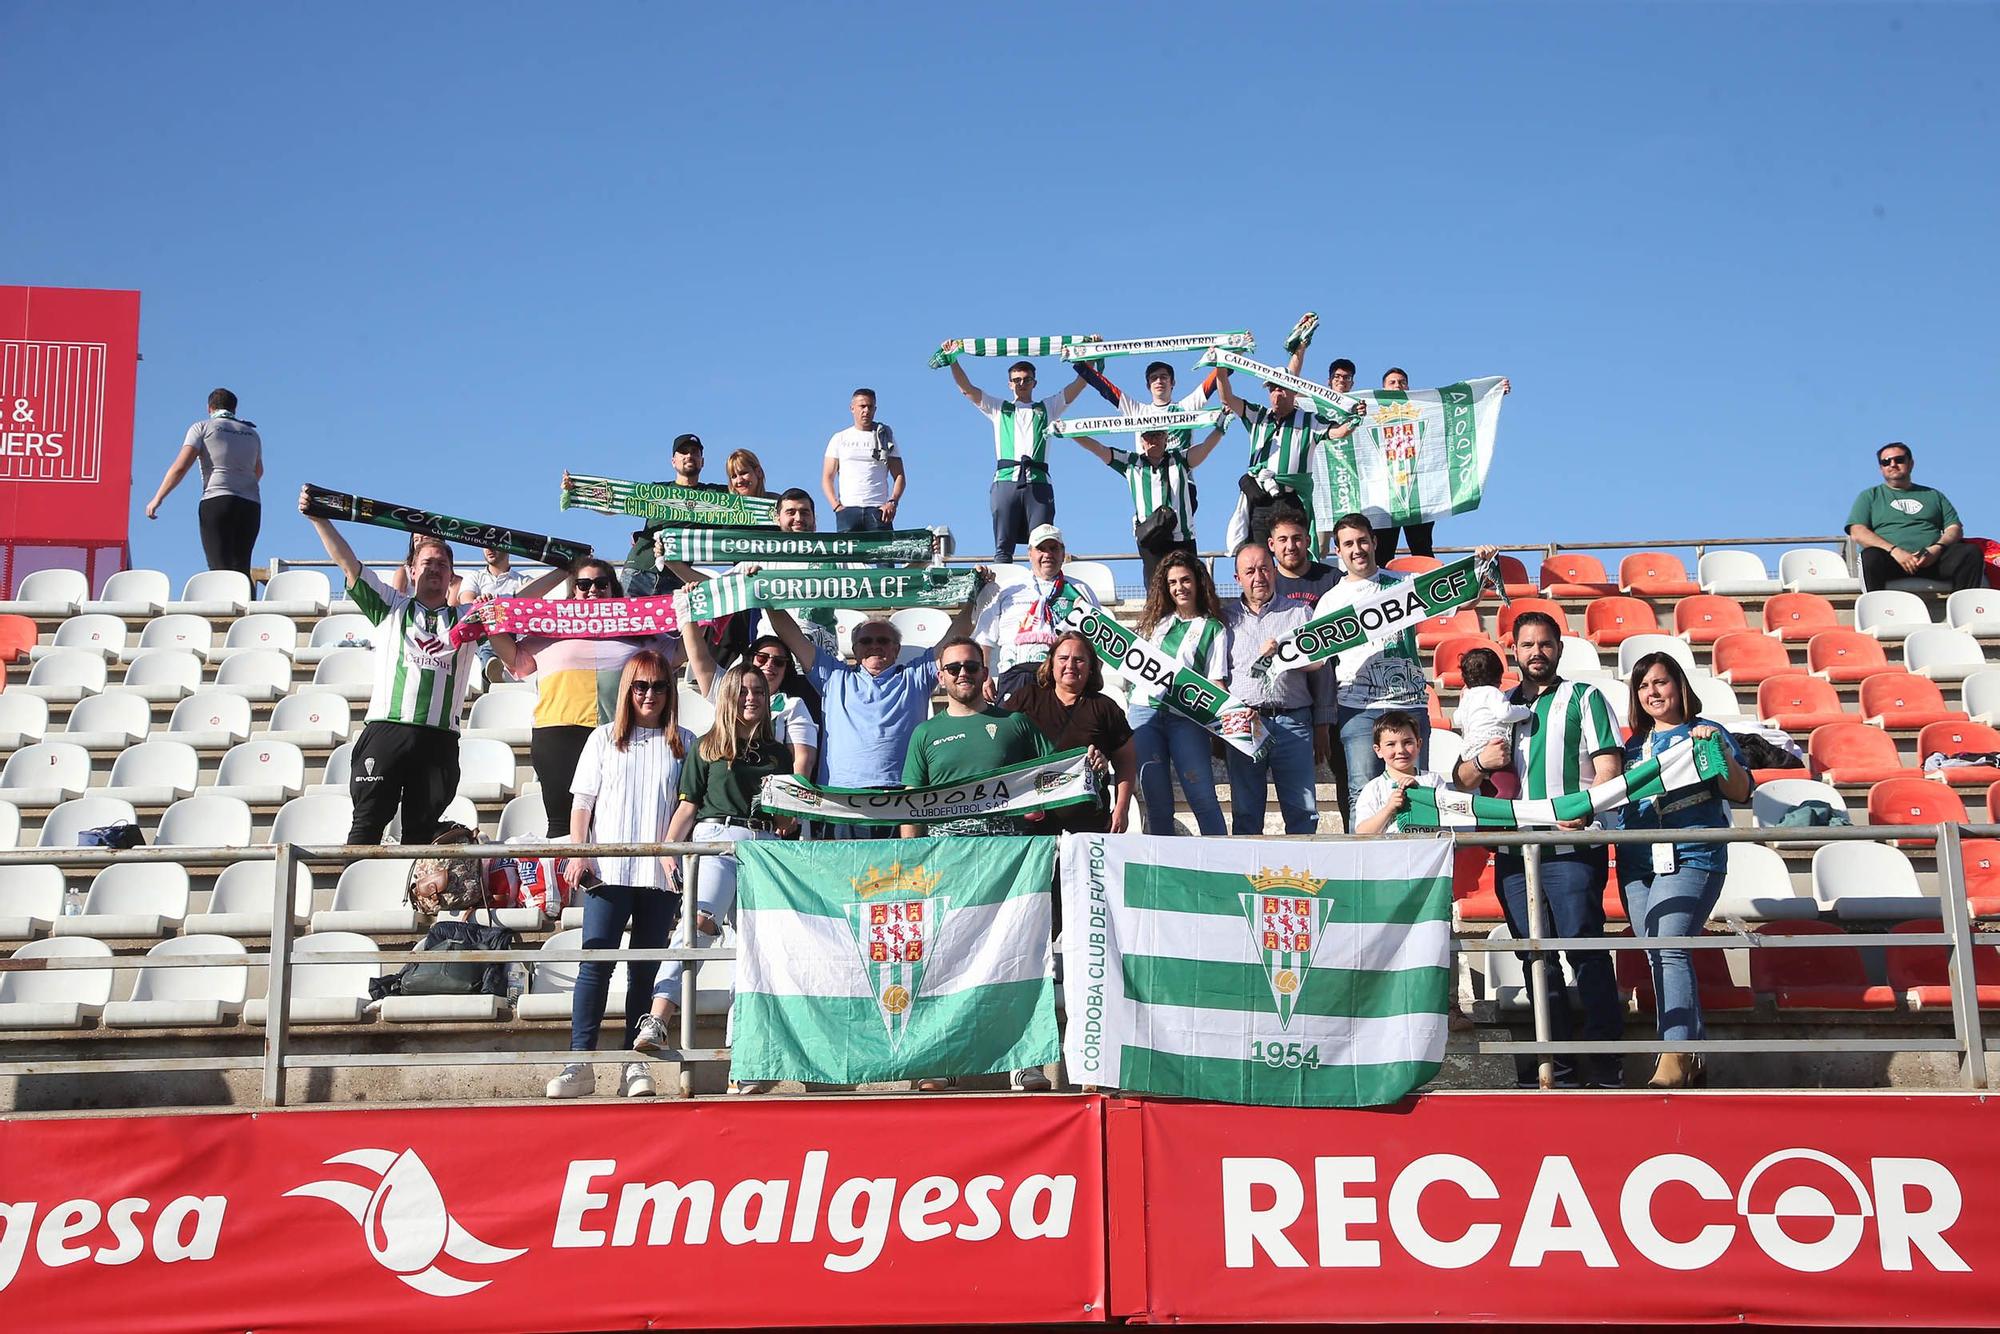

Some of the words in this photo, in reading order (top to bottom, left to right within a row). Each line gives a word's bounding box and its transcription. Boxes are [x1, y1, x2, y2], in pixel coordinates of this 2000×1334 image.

[1095, 341, 1141, 353] CALIFATO
[1144, 335, 1217, 350] BLANQUIVERDE
[1224, 353, 1269, 375] CALIFATO
[1272, 371, 1344, 405] BLANQUIVERDE
[12, 398, 35, 423] &
[1075, 418, 1122, 430] CALIFATO
[1125, 413, 1199, 427] BLANQUIVERDE
[624, 497, 666, 518] CLUB
[669, 507, 691, 522] DE
[720, 538, 827, 556] CORDOBA
[834, 539, 859, 555] CF
[691, 586, 708, 616] 1954
[753, 576, 874, 600] CORDOBA
[881, 575, 911, 599] CF
[556, 602, 627, 618] MUJER
[1277, 591, 1430, 663] CÓRDOBA
[1430, 570, 1468, 603] CF
[528, 615, 657, 634] CORDOBESA
[405, 653, 451, 671] CajaSur
[1064, 606, 1176, 695] CÓRDOBA
[1178, 683, 1216, 711] CF
[1086, 837, 1106, 903] FÚTBOL
[1090, 905, 1106, 929] DE
[1088, 932, 1106, 979] CLUB
[1080, 983, 1105, 1073] CÓRDOBA
[1251, 1040, 1320, 1069] 1954
[552, 1148, 1077, 1275] Emalgesa
[1220, 1147, 1974, 1274] RECACOR
